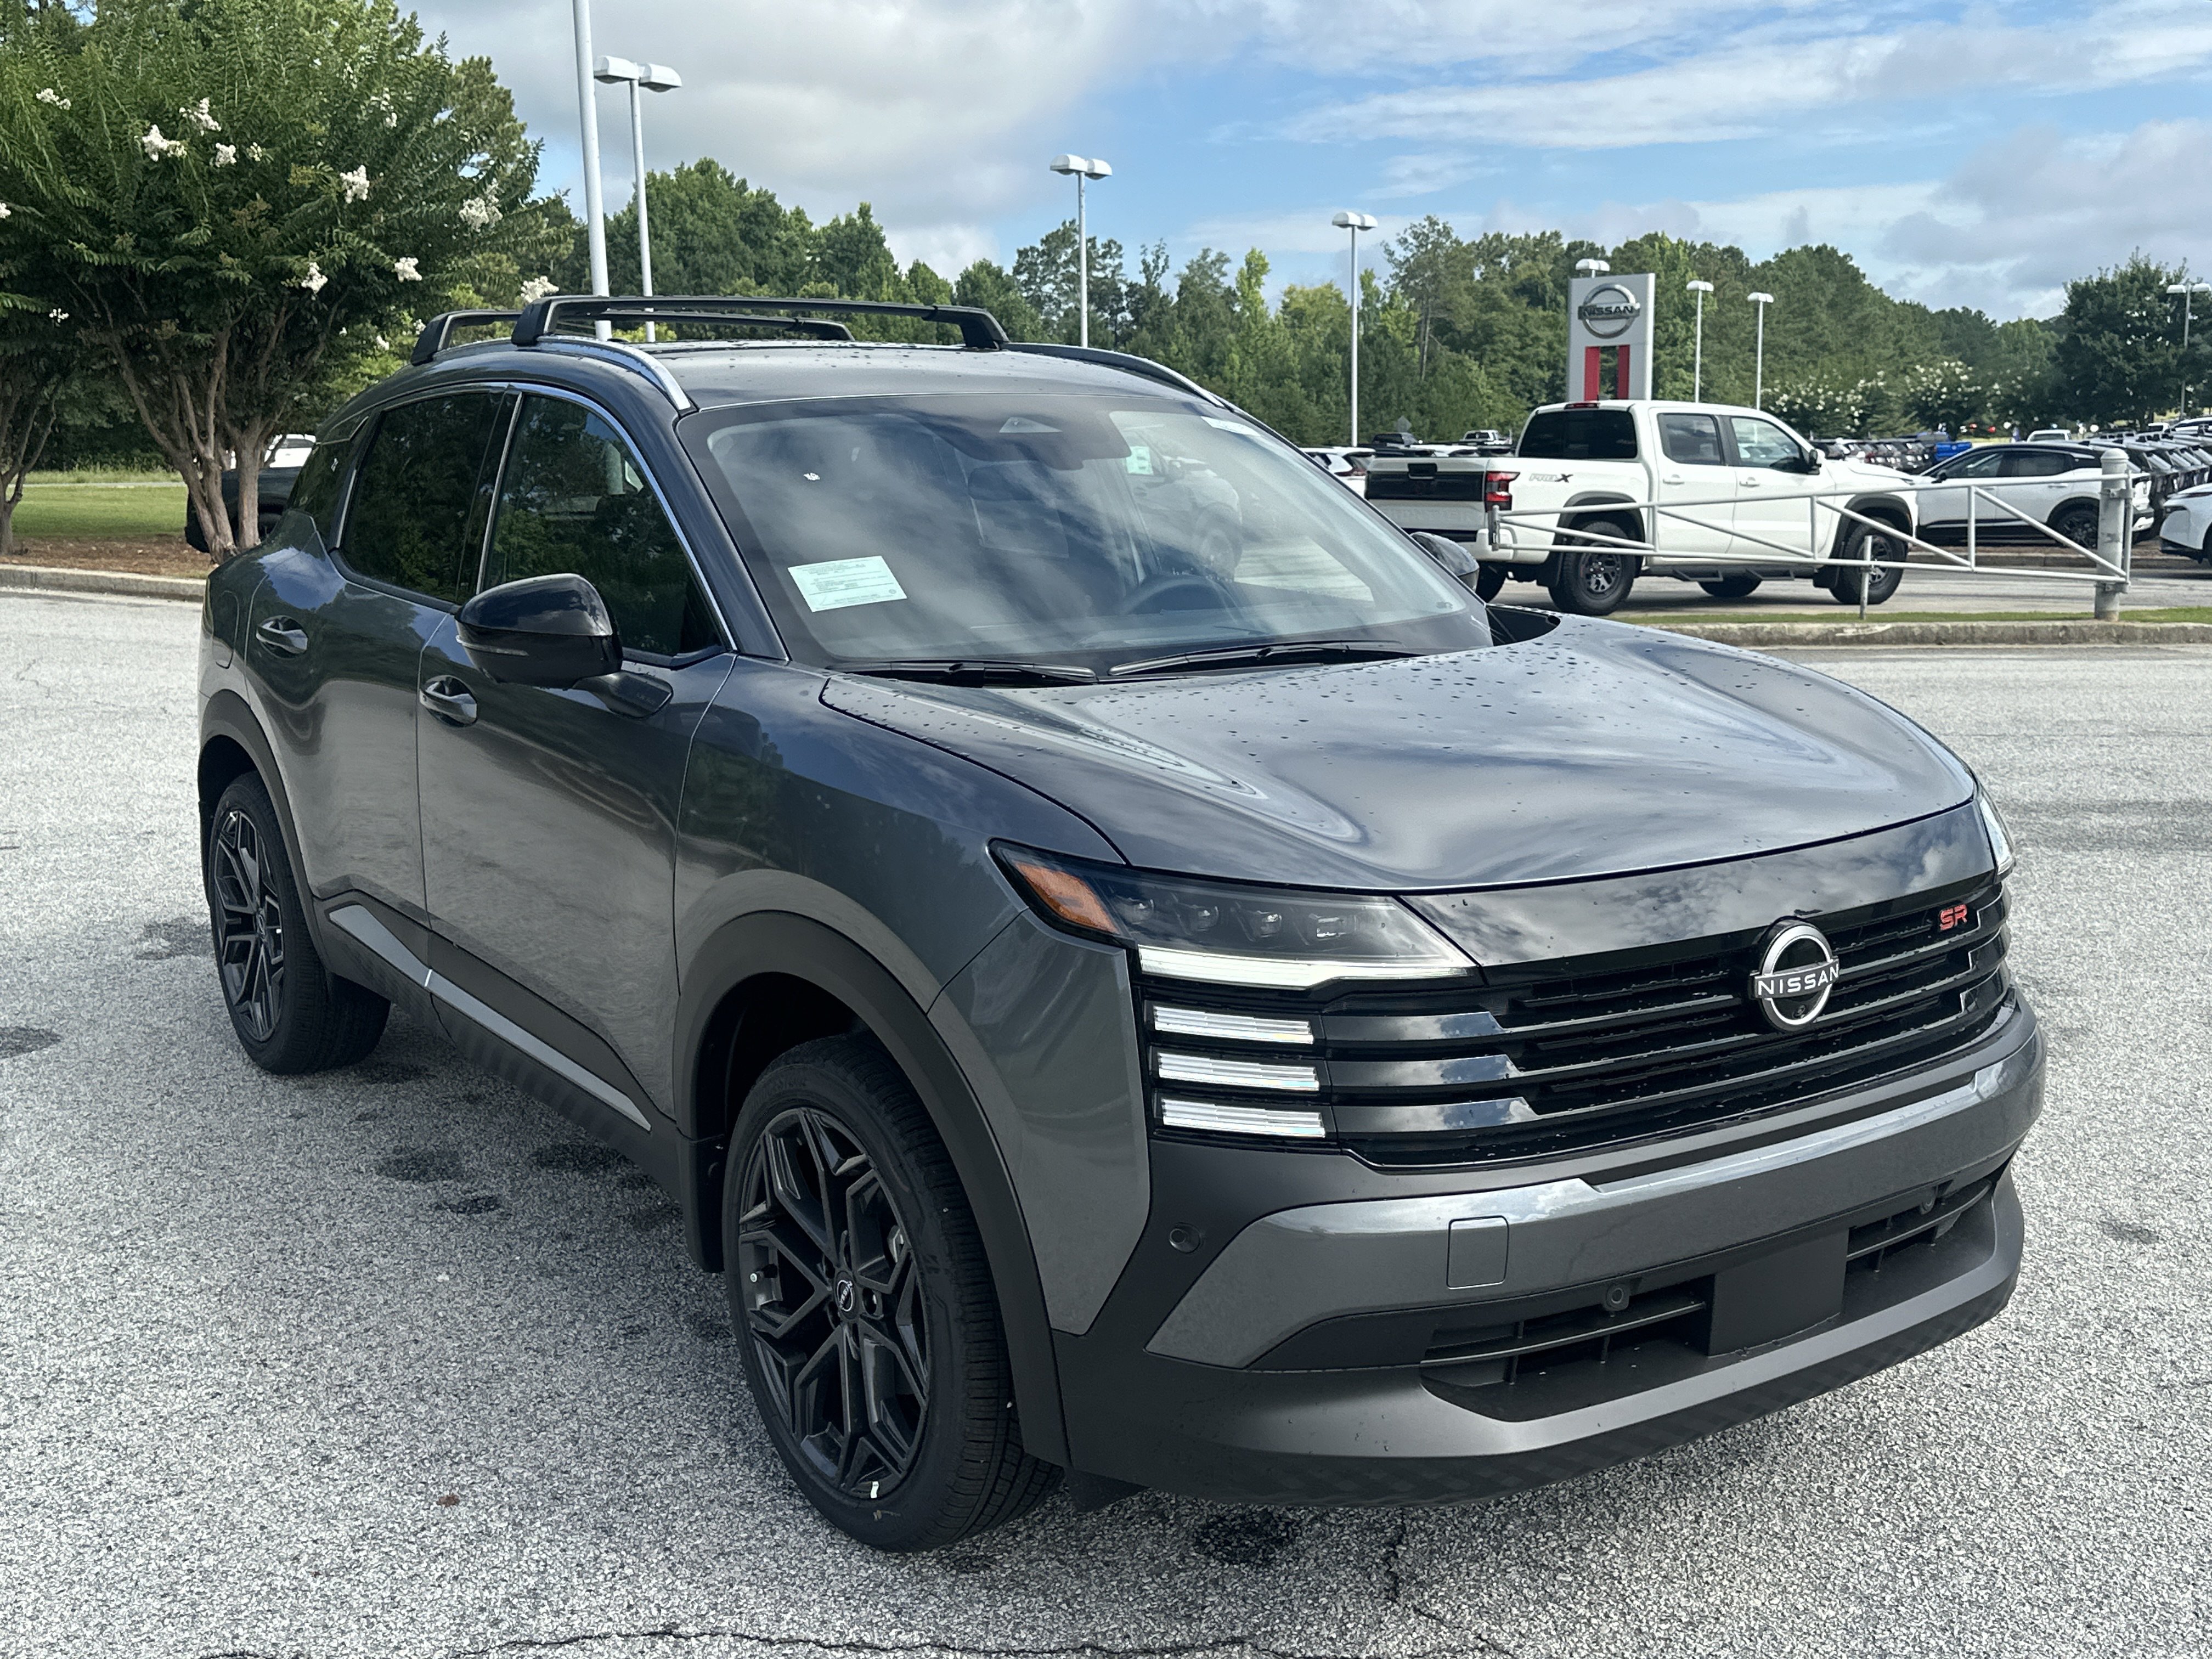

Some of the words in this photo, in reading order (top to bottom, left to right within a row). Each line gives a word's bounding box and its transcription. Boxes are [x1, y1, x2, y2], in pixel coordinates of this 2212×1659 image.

[1582, 306, 1634, 317] NISSAN
[1939, 904, 1967, 930] SR
[1758, 963, 1839, 995] NISSAN
